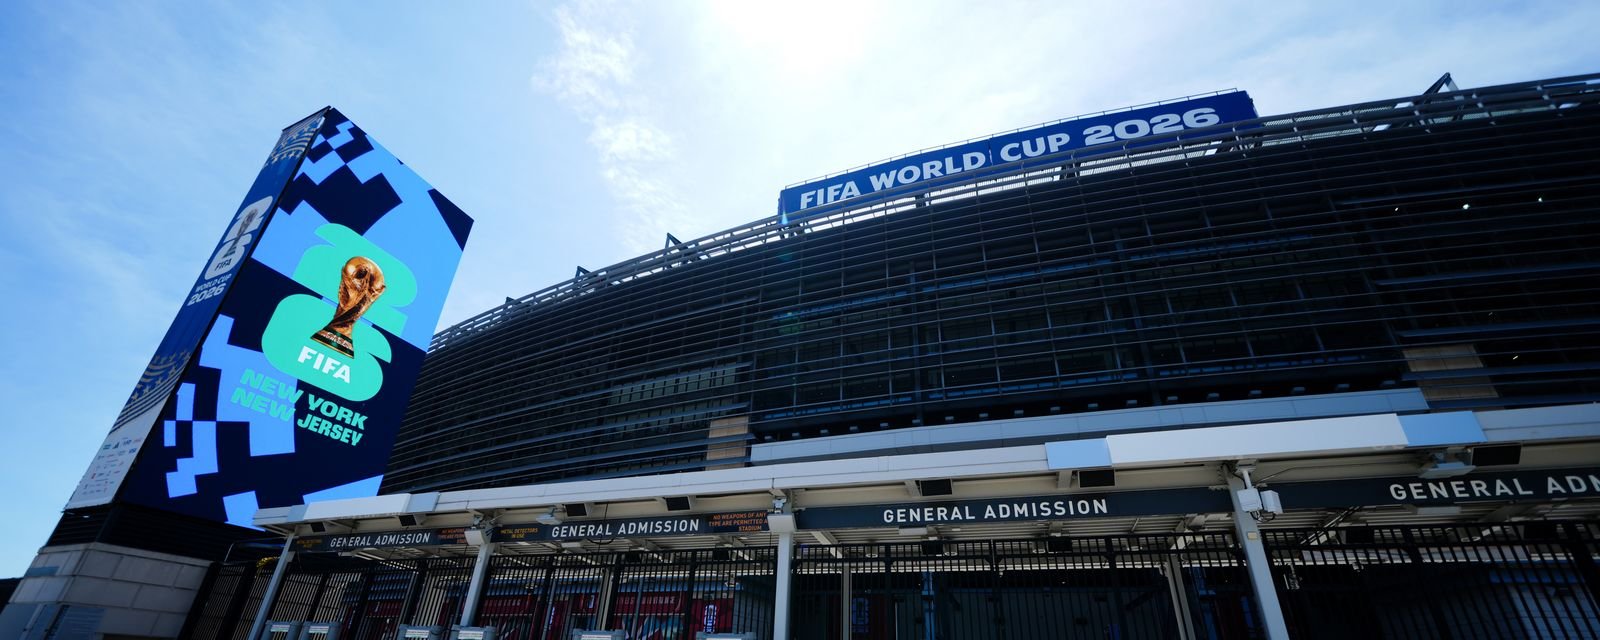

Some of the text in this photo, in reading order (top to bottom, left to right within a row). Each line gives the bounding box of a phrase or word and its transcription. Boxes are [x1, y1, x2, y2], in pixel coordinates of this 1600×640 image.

[800, 107, 1221, 210] FIFA WORLD CUP 2026
[214, 258, 232, 271] FIFA
[195, 273, 232, 292] WORLD CUP
[187, 282, 227, 306] 2026
[297, 345, 351, 384] FIFA
[240, 368, 369, 431] NEW YORK
[230, 386, 364, 447] NEW JERSEY
[1389, 478, 1533, 501] GENERAL
[721, 512, 748, 520] WEAPONS
[732, 518, 764, 526] PERMITTED
[882, 498, 1109, 524] GENERAL ADMISSION
[551, 518, 700, 539] GENERAL ADMISSION
[738, 524, 762, 532] STADIUM
[330, 535, 372, 548] GENERAL
[374, 532, 431, 546] ADMISSION
